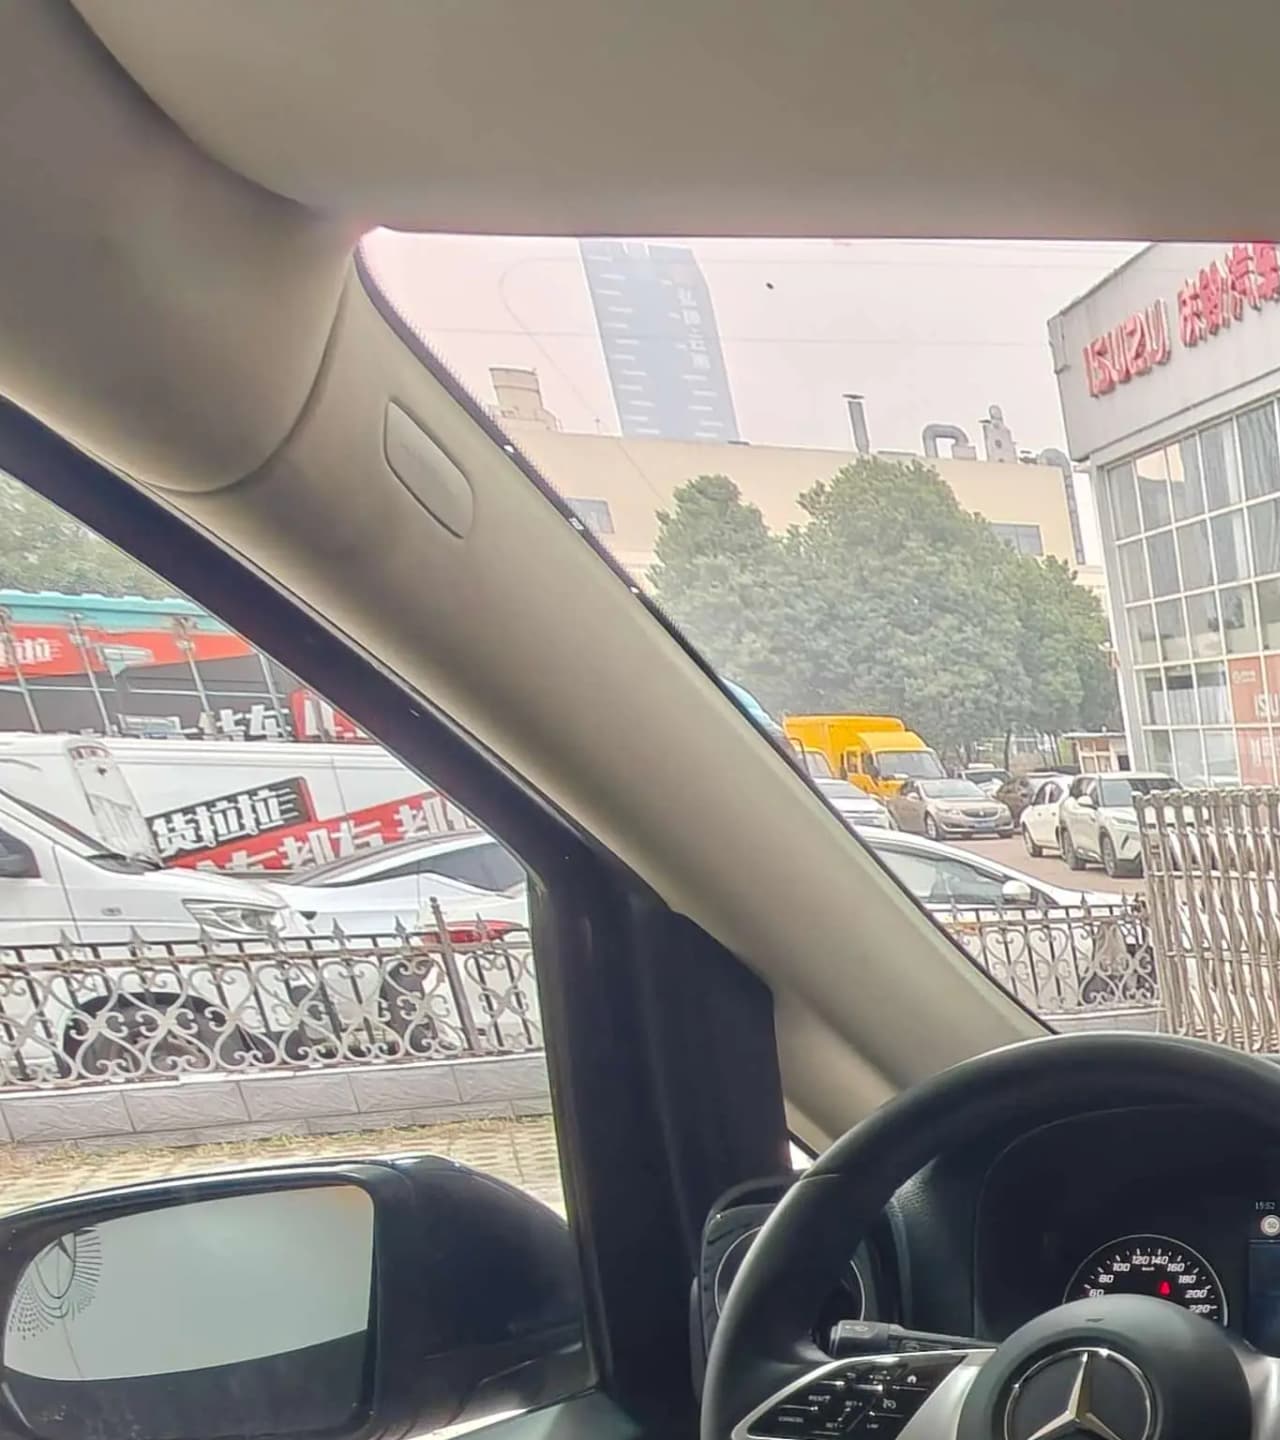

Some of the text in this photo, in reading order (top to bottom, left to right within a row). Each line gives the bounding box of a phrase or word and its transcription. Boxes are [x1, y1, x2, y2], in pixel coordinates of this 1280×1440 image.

[1083, 298, 1170, 398] ISUZU
[152, 784, 297, 855] 货拉拉
[1132, 1256, 1149, 1265] 120
[1151, 1256, 1169, 1265] 140
[1112, 1263, 1131, 1272] 100
[1167, 1263, 1185, 1272] 160
[1098, 1275, 1114, 1283] 80
[1178, 1275, 1197, 1283] 180
[1184, 1290, 1207, 1298] 200
